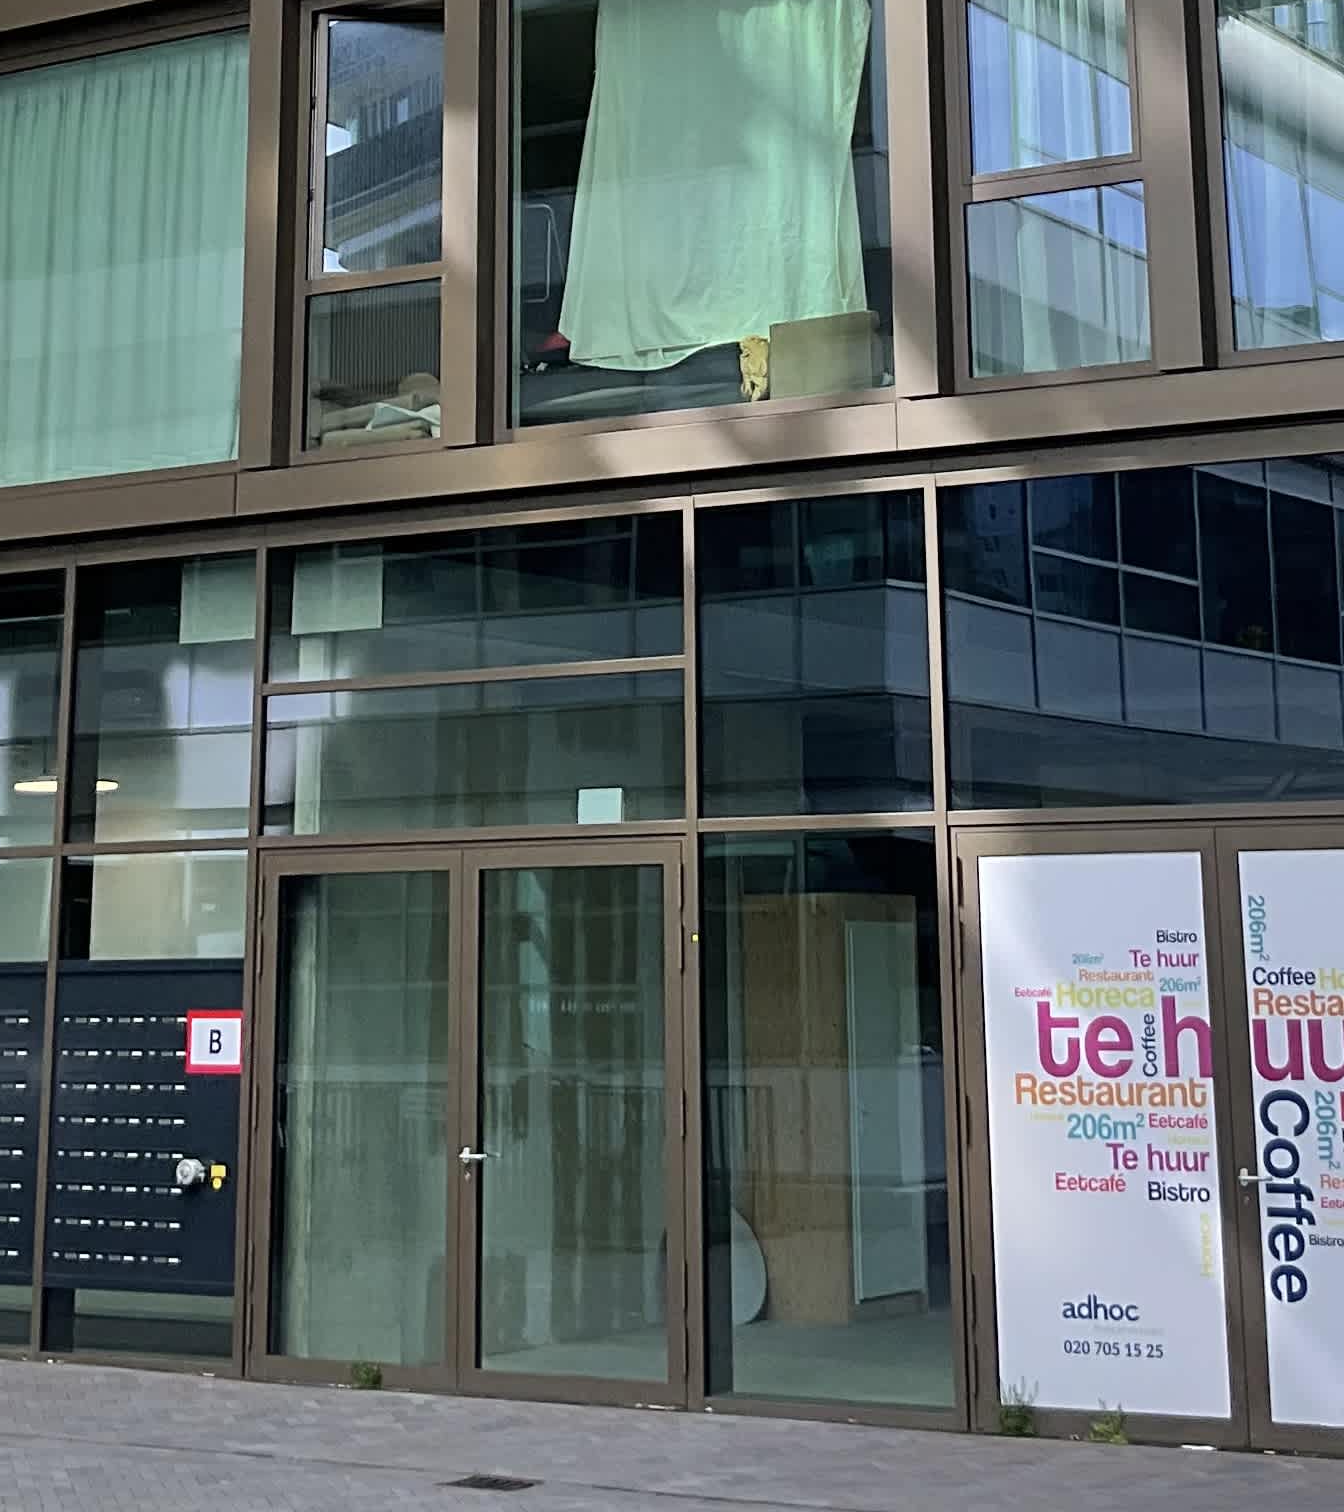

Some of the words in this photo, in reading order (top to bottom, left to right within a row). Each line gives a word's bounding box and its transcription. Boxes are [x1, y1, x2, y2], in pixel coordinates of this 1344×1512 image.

[1156, 930, 1197, 943] Bistro
[1129, 949, 1151, 967] Te
[1157, 949, 1199, 967] huur
[1079, 968, 1154, 982] Restaurant
[1252, 966, 1316, 986] Coffee
[1056, 982, 1155, 1008] Horeca
[209, 1029, 222, 1054] B
[1037, 1001, 1134, 1078] te
[1143, 1013, 1158, 1077] Coffee
[1015, 1072, 1206, 1107] Restaurant
[1149, 1113, 1208, 1128] Eetcafé
[1106, 1143, 1138, 1170] Te
[1147, 1143, 1210, 1172] huur
[1055, 1172, 1126, 1192] Eetcafé
[1148, 1181, 1210, 1202] Bistro
[1260, 1089, 1316, 1303] Coffee
[1309, 1234, 1344, 1248] Bistro
[1062, 1294, 1140, 1321] adhoc
[1064, 1339, 1090, 1354] 020
[1094, 1341, 1120, 1356] 705
[1126, 1342, 1142, 1357] 15
[1146, 1343, 1164, 1358] 25
